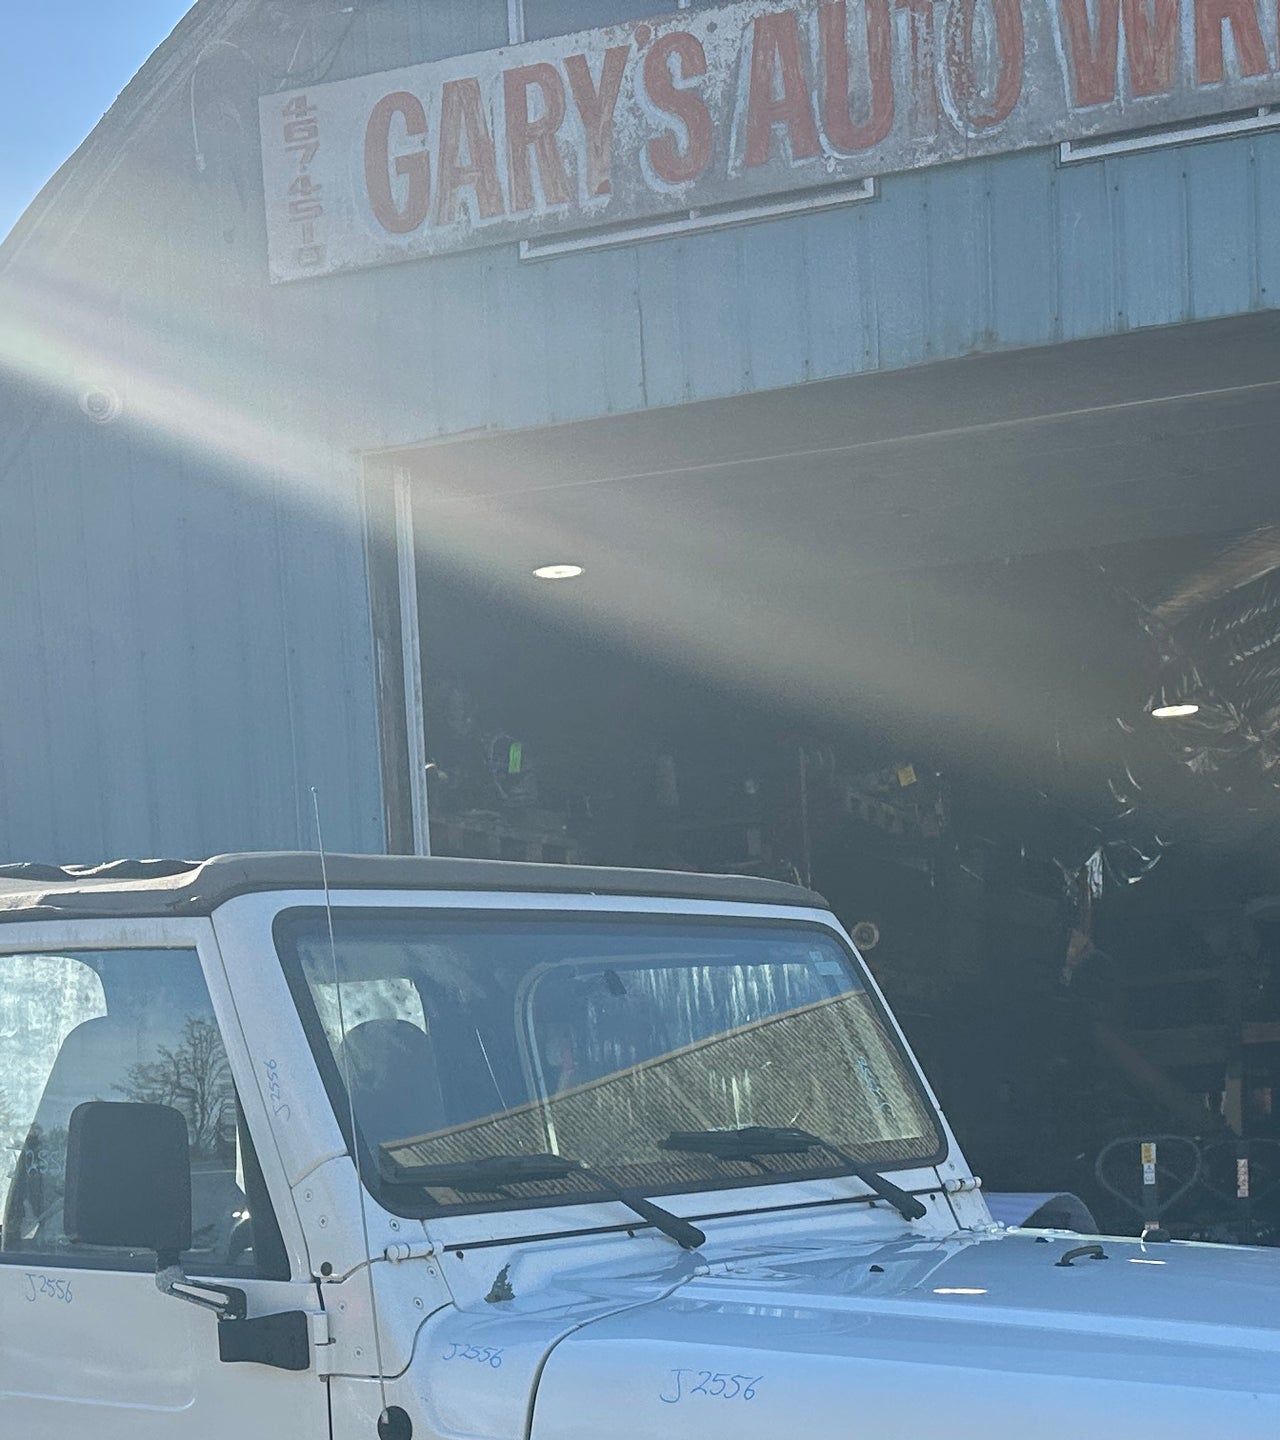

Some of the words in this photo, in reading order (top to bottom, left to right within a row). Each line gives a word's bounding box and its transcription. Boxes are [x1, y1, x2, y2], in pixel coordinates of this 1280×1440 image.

[364, 27, 708, 235] GARY'S
[742, 0, 1024, 167] AUTO
[264, 1059, 291, 1121] J2556
[25, 1272, 74, 1304] J2556
[442, 1342, 505, 1369] J2556
[659, 1368, 764, 1404] J2556
